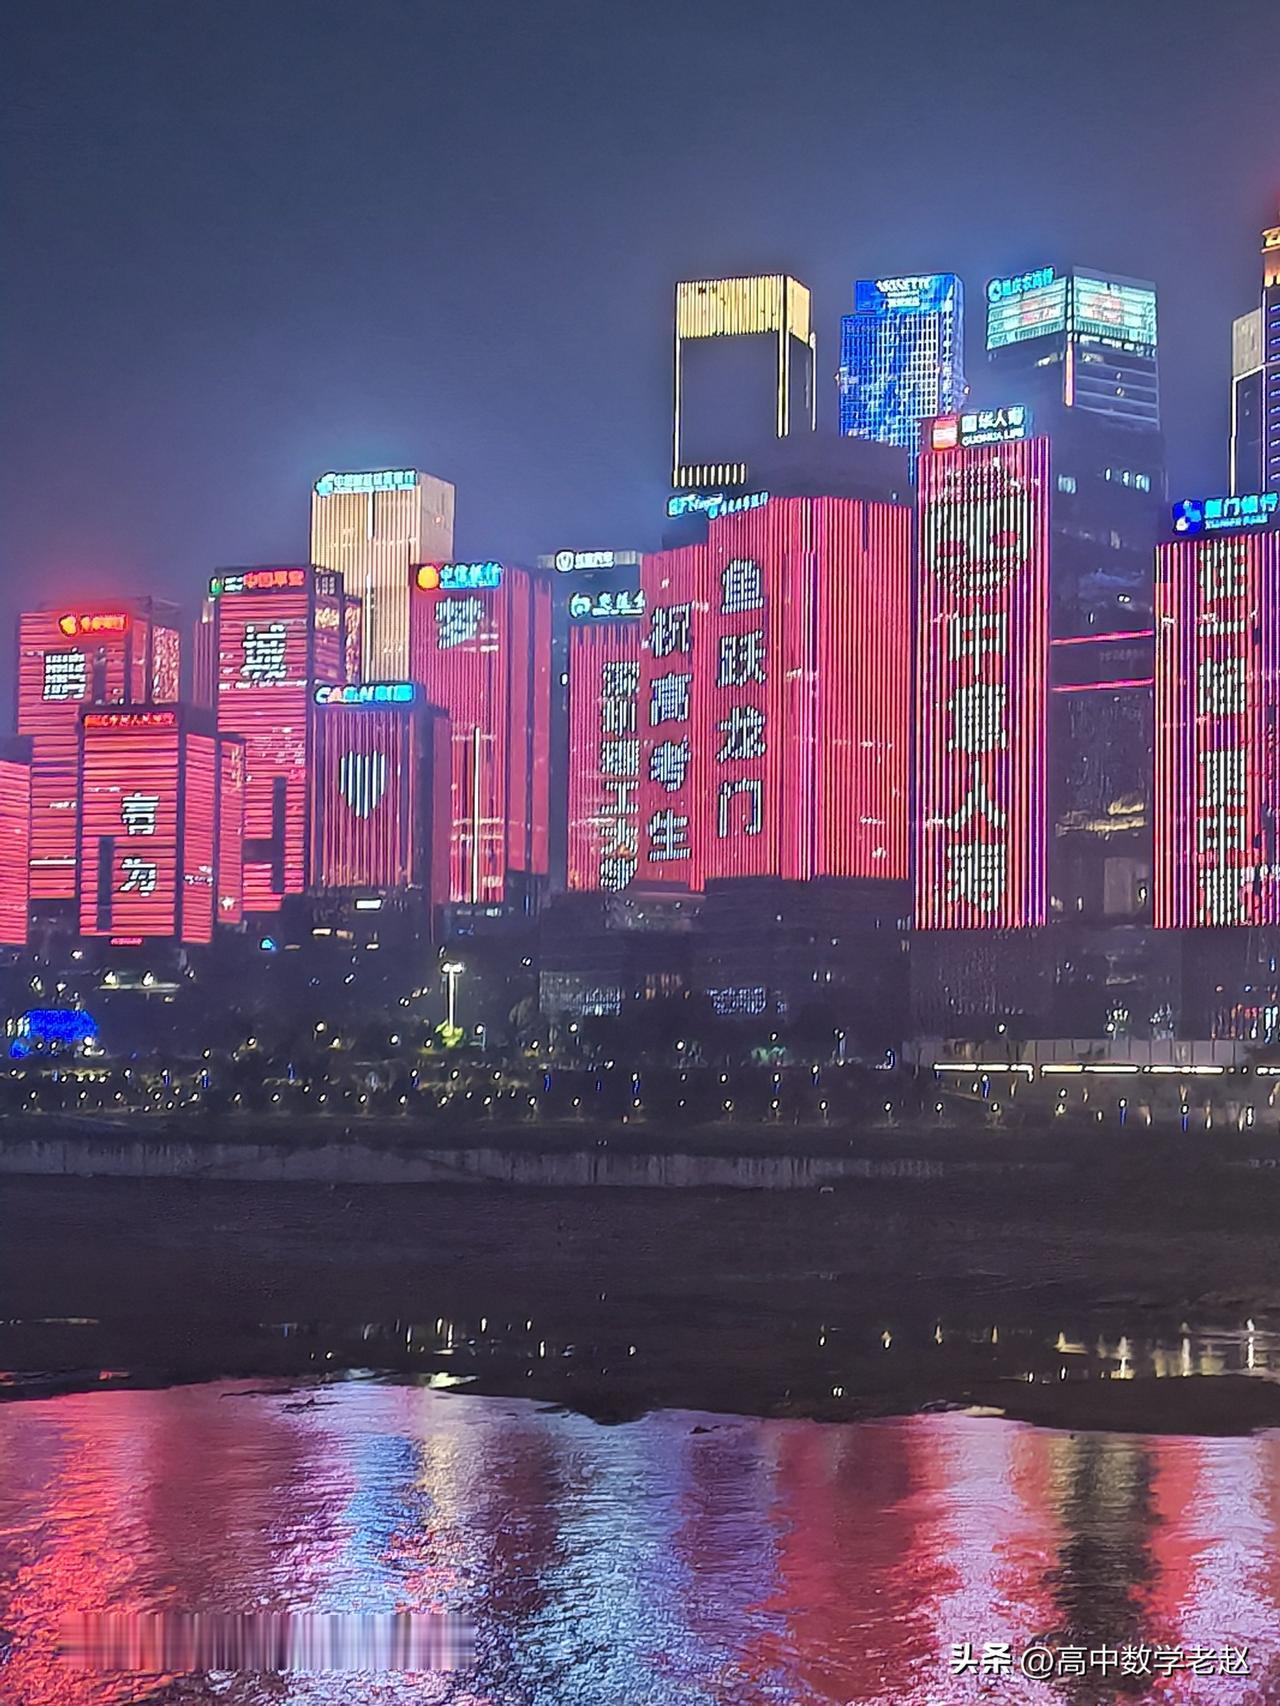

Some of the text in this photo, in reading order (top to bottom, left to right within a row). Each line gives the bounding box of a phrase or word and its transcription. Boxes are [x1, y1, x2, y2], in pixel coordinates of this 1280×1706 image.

[435, 596, 485, 650] 梦
[649, 603, 692, 862] 祝高考生
[716, 558, 767, 838] 鱼跃龙门
[600, 661, 640, 892] 深圳理工大学
